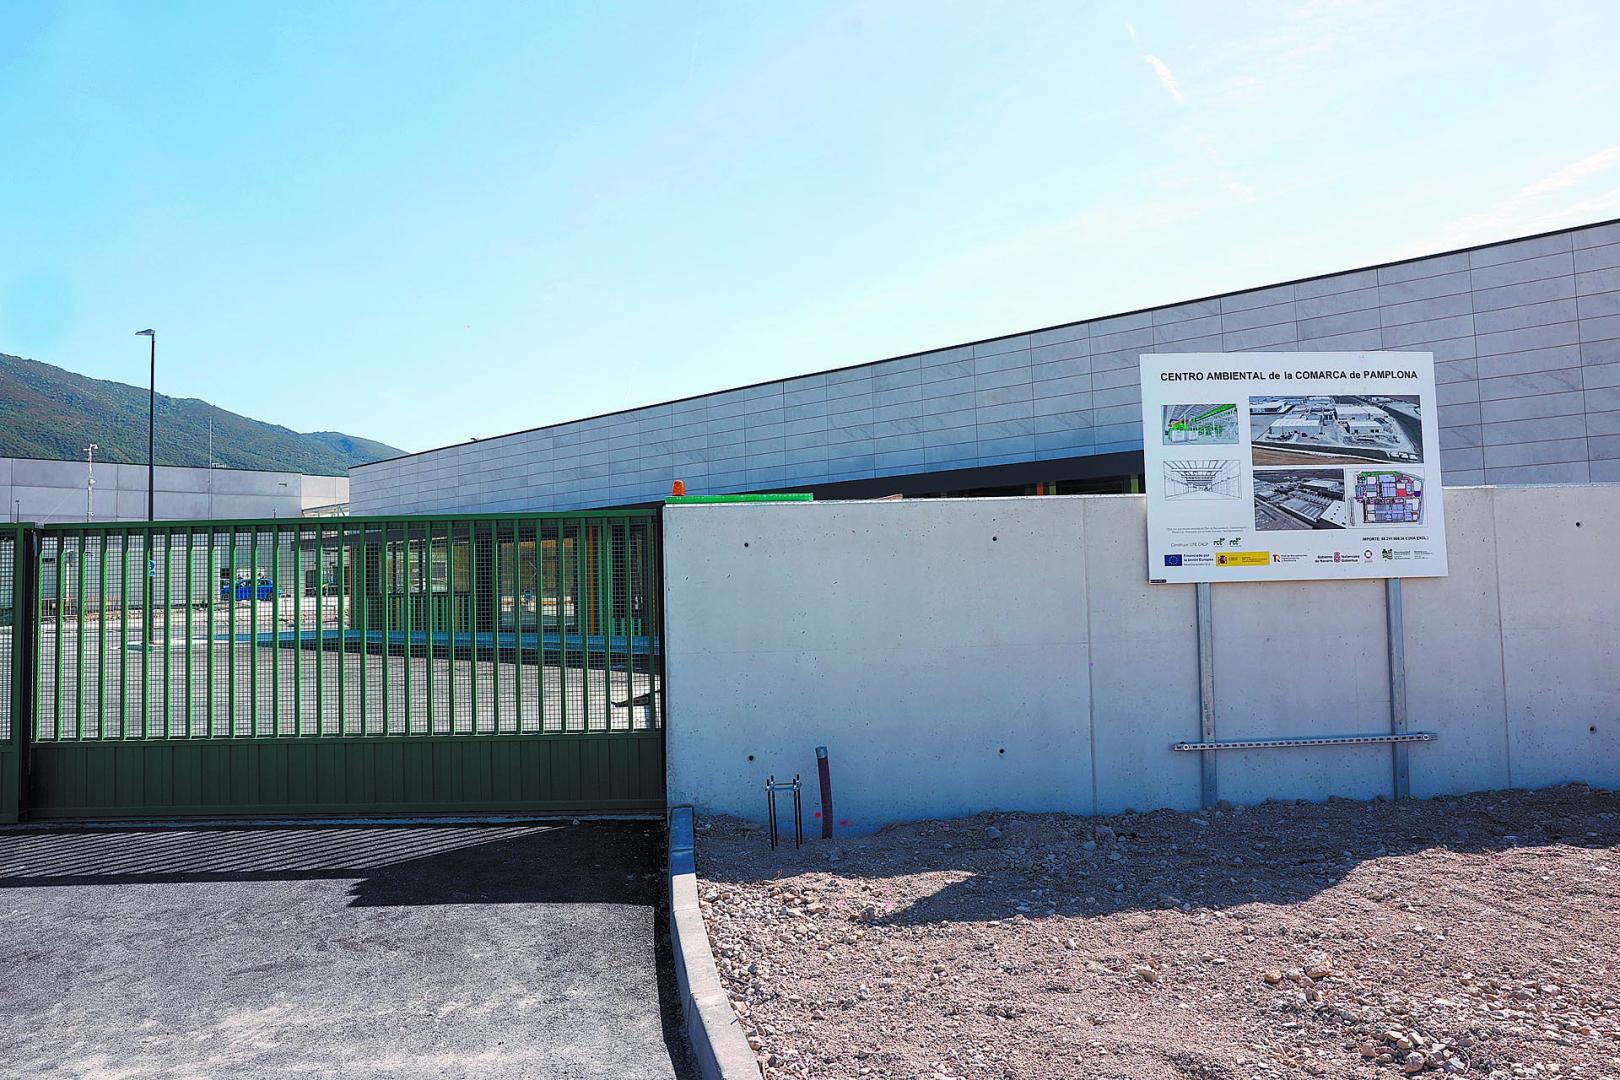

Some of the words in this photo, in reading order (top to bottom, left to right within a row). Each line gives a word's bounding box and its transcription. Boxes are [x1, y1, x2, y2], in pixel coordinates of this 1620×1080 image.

[1160, 372, 1204, 381] CENTRO
[1206, 371, 1266, 381] AMBIENTAL
[1268, 371, 1281, 380] de
[1284, 371, 1293, 380] la
[1295, 370, 1347, 380] COMARCA
[1349, 370, 1361, 379] de
[1363, 370, 1418, 379] PAMPLONA
